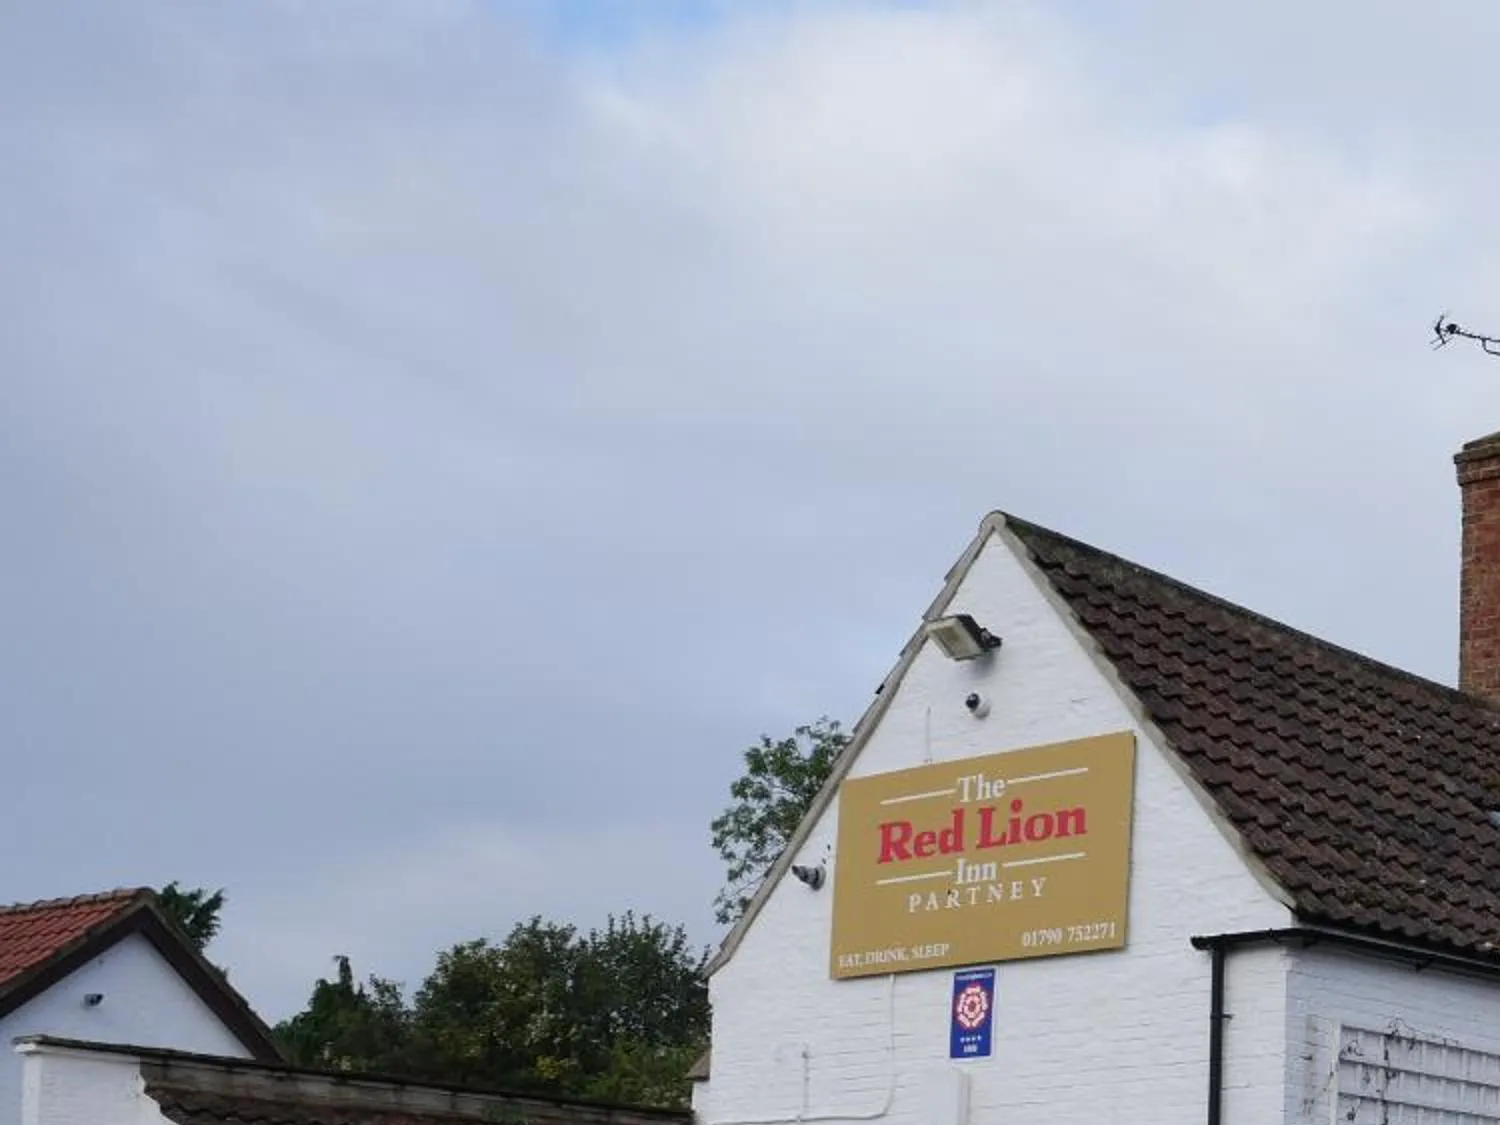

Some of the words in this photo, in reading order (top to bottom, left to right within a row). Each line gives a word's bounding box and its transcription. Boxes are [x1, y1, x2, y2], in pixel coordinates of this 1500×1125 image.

[955, 773, 1006, 802] The
[876, 808, 964, 865] Red
[975, 799, 1088, 850] Lion
[956, 857, 997, 885] Inn
[908, 876, 1047, 913] PARTNEY
